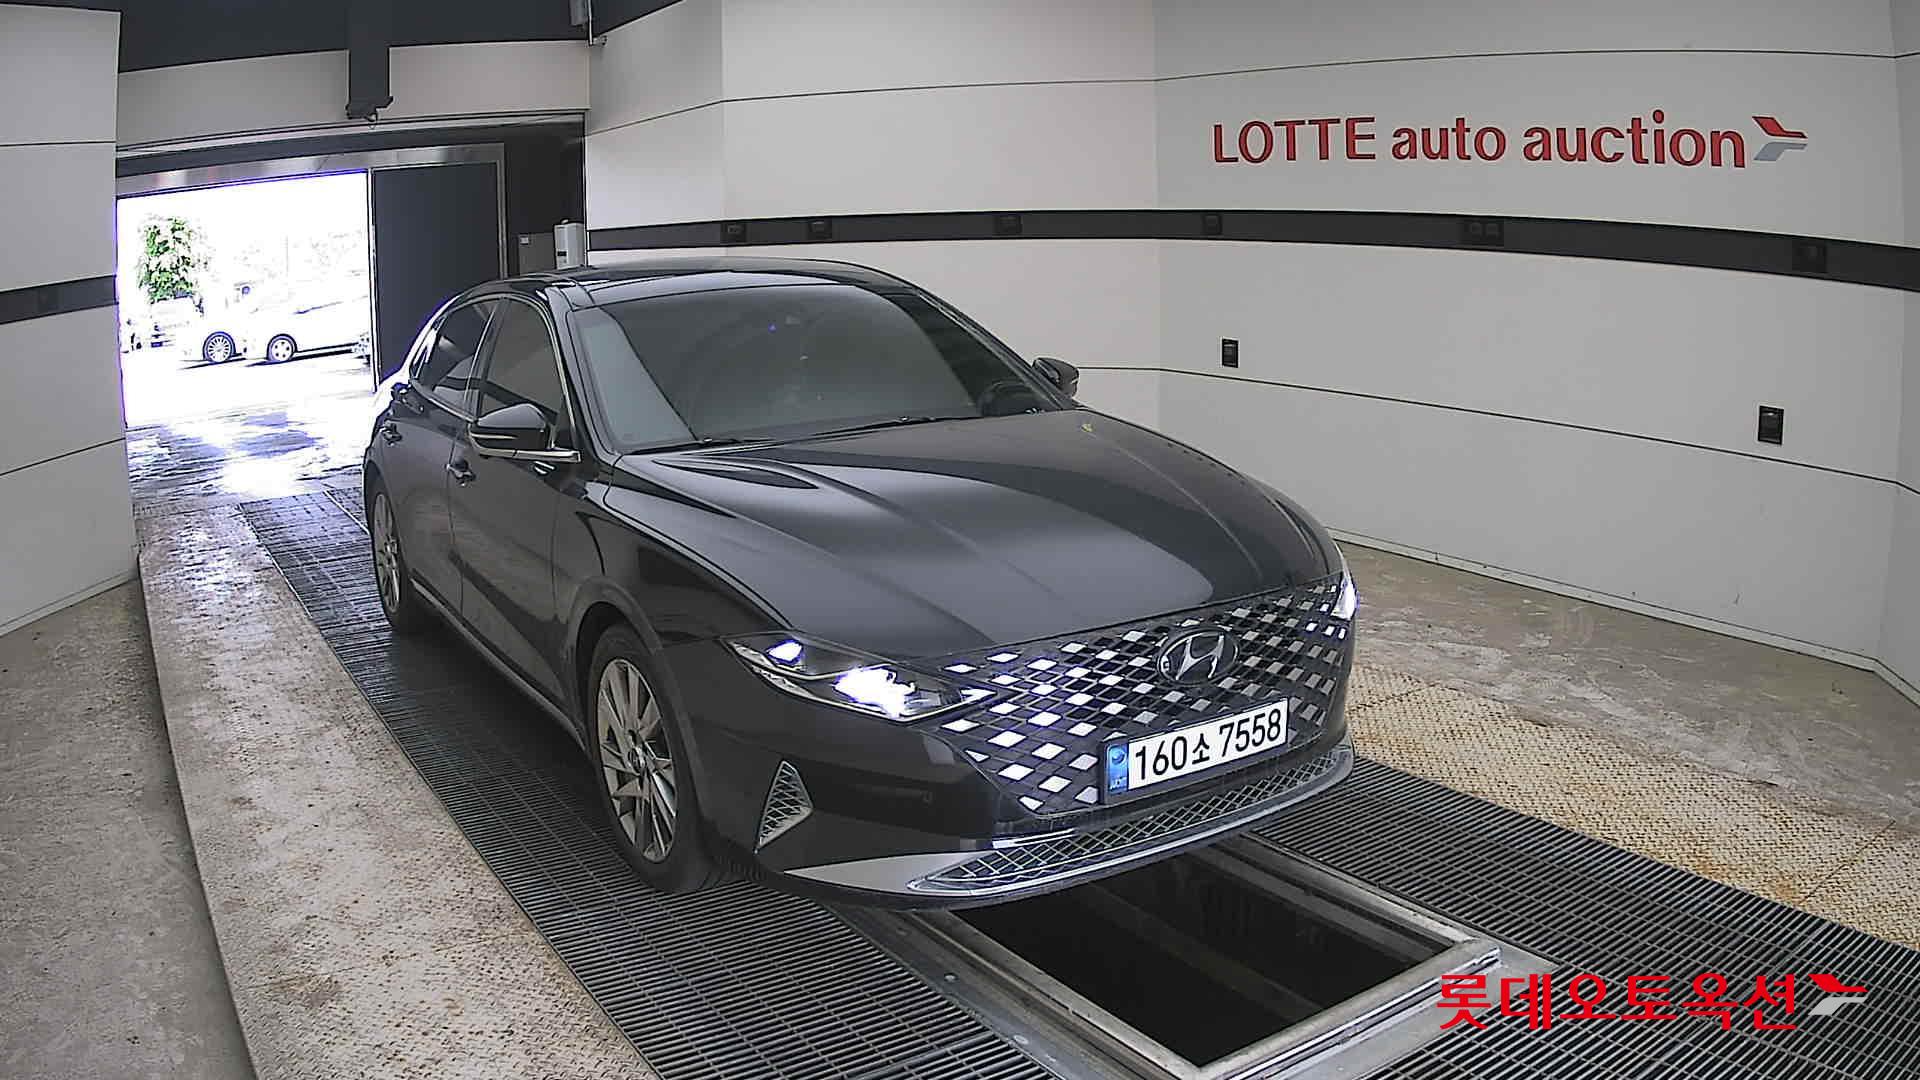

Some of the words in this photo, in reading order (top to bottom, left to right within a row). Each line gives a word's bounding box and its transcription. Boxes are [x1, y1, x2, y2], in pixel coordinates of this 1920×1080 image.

[1213, 116, 1376, 164] LOTTE
[1391, 116, 1507, 161] auto
[1522, 109, 1747, 169] auction
[1219, 708, 1282, 758] 7558
